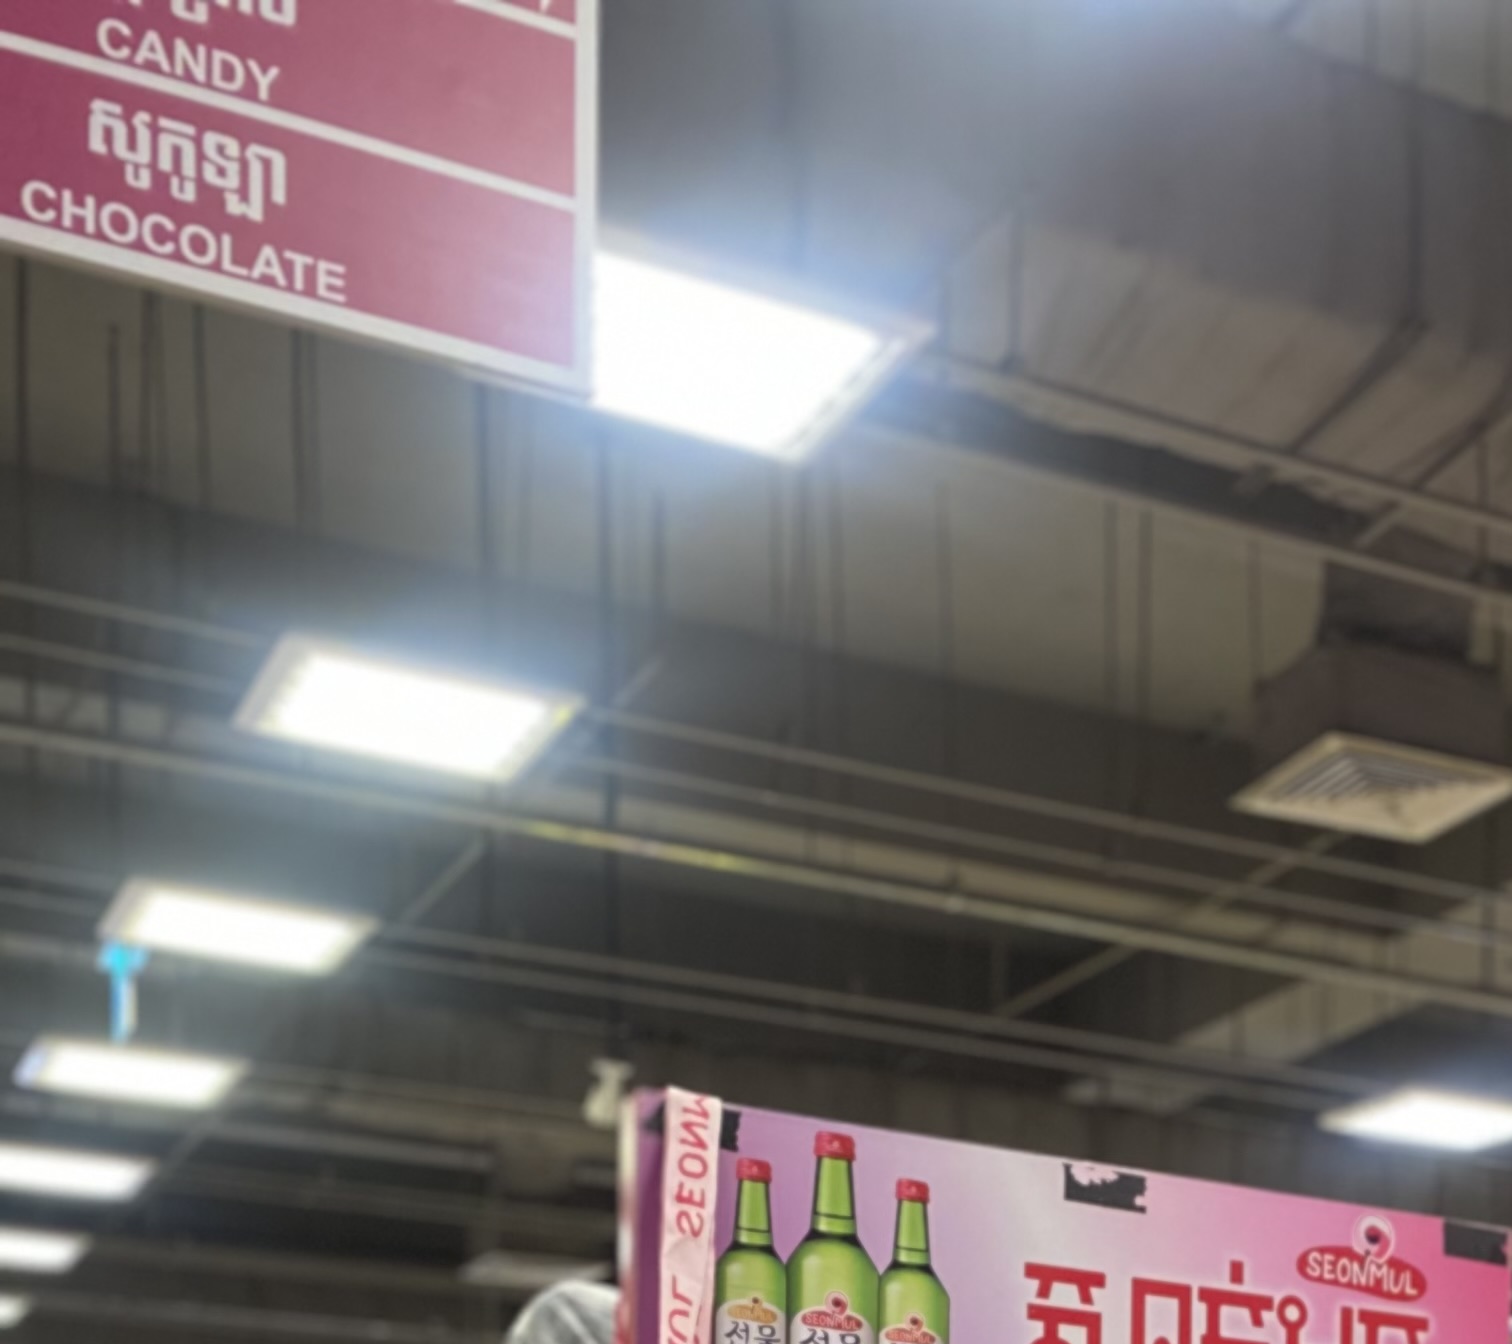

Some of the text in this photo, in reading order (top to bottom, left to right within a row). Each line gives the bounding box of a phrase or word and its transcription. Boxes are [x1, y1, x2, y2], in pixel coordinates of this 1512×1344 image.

[96, 18, 280, 101] CANDY
[88, 98, 286, 222] សូកូឡា
[20, 180, 347, 303] CHOCOLATE
[1307, 1251, 1418, 1294] SEONMUL
[803, 1312, 860, 1330] SEONMUL
